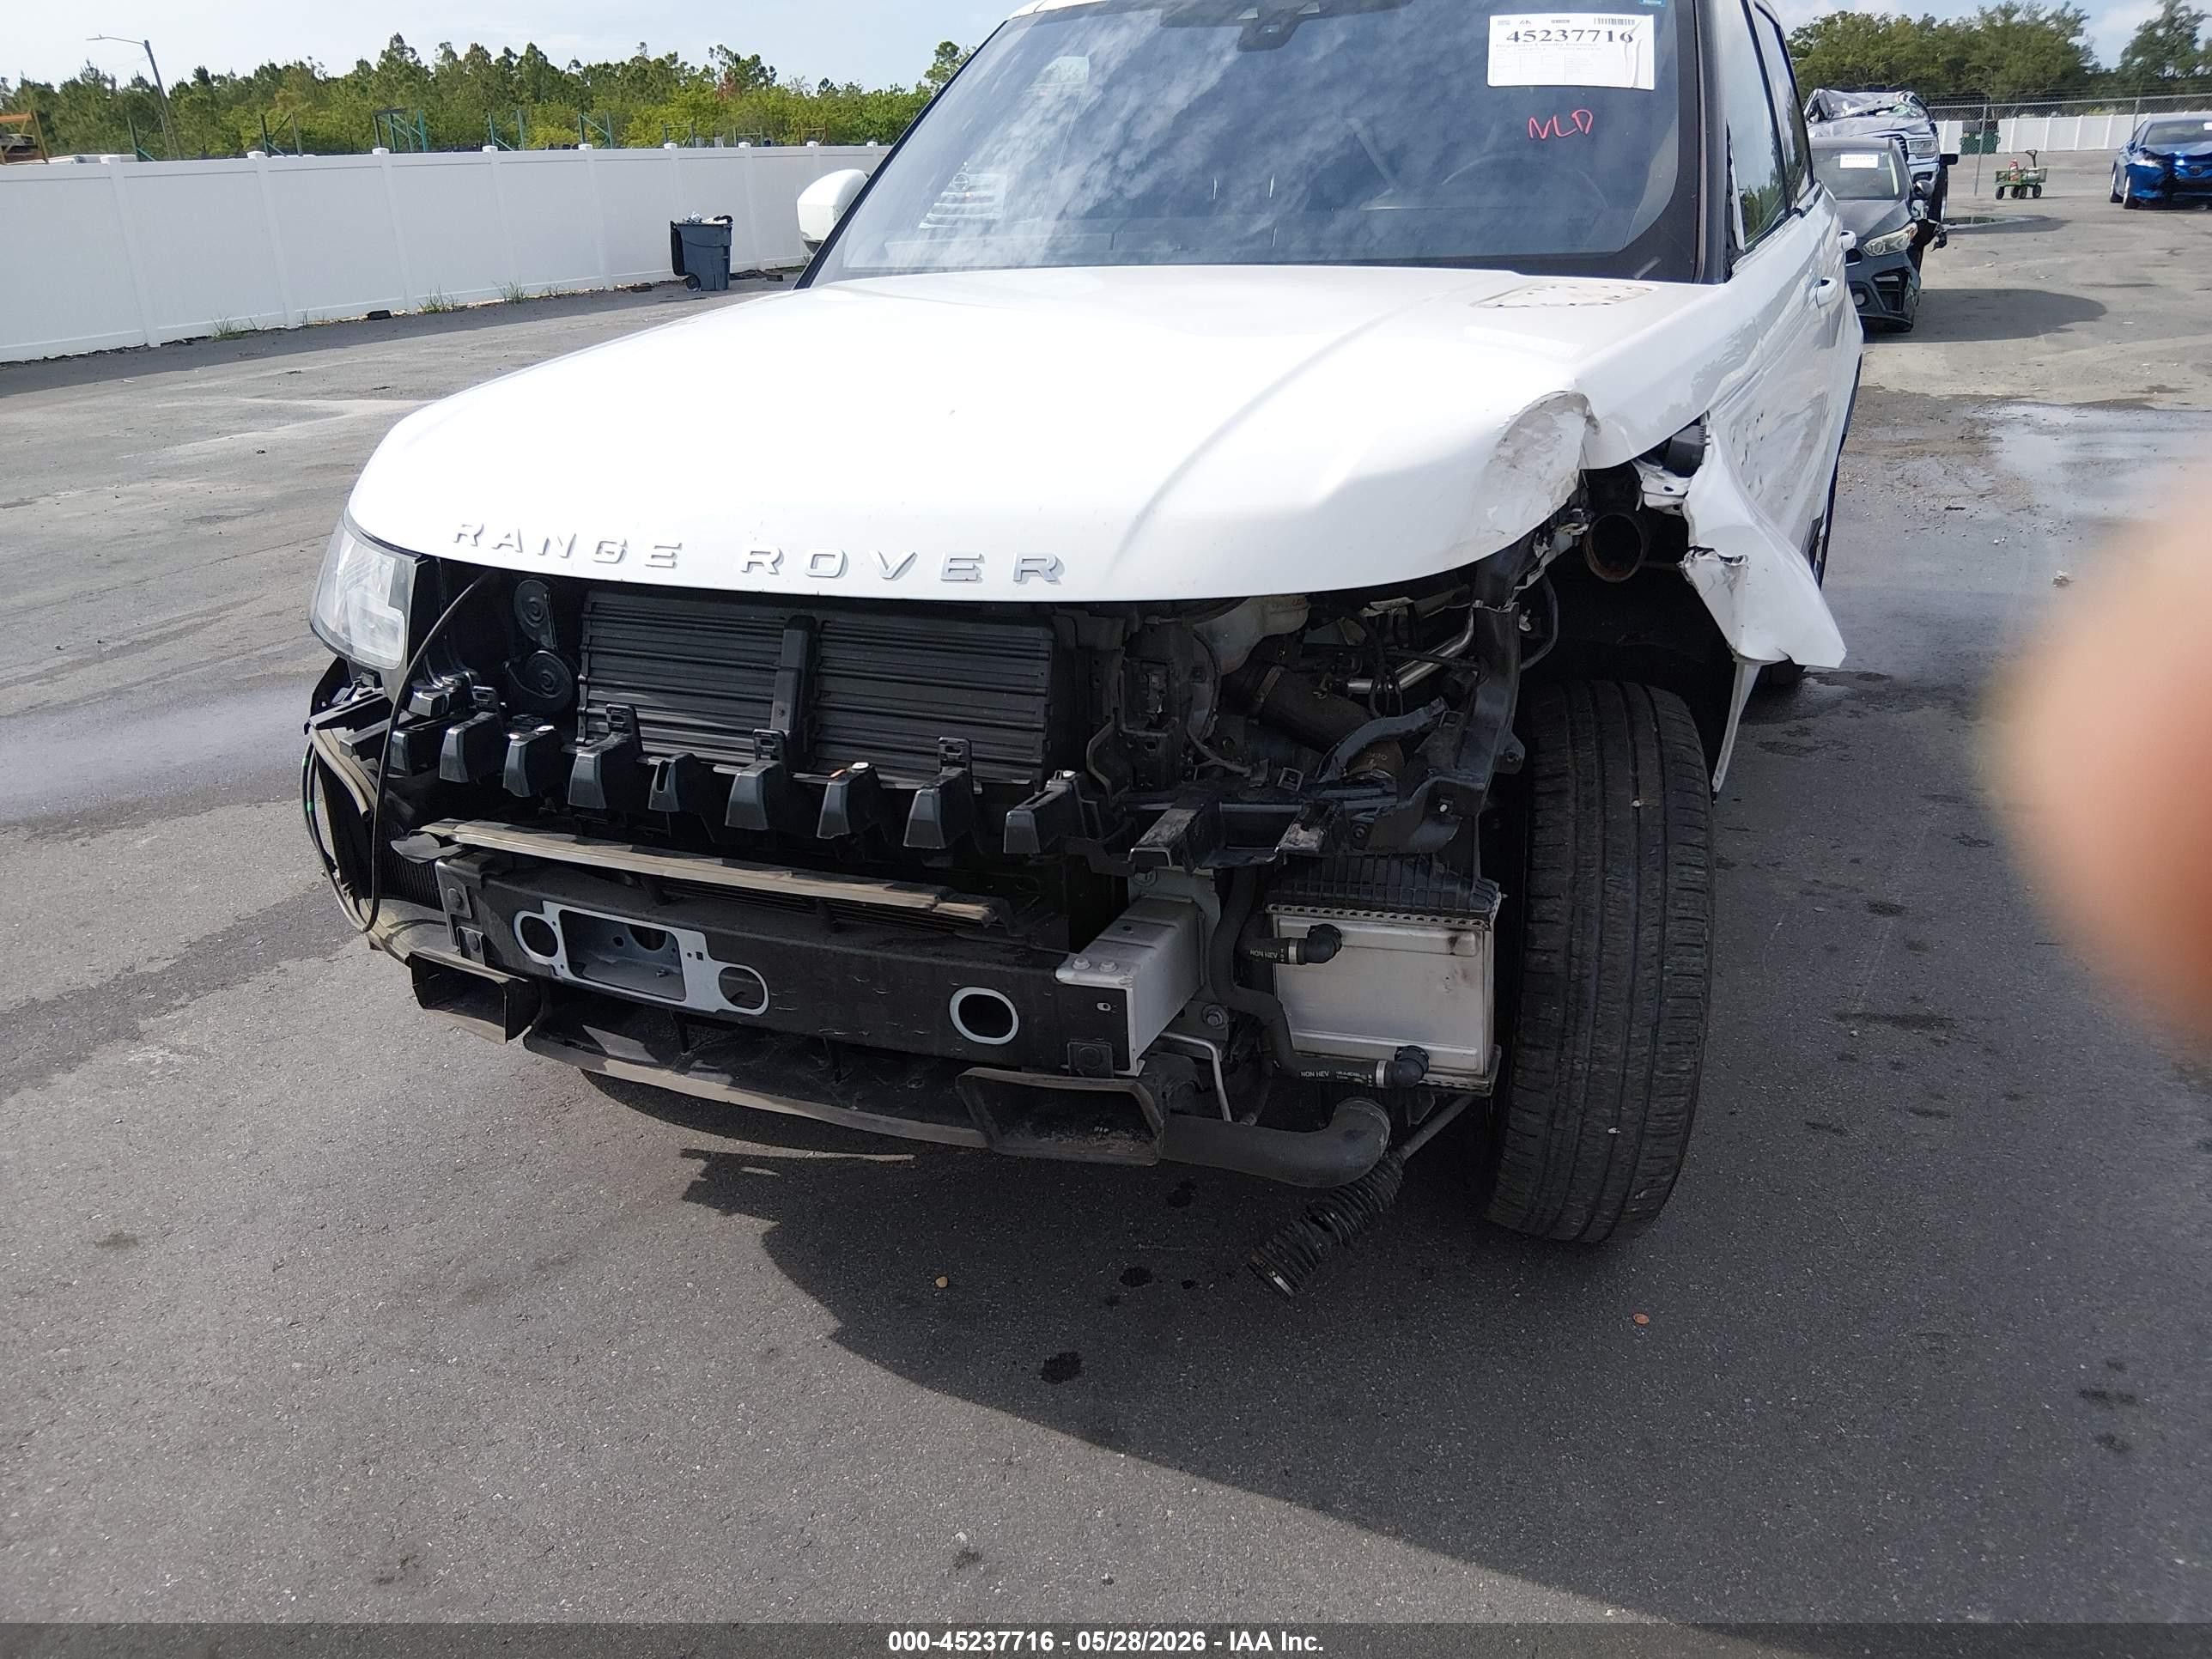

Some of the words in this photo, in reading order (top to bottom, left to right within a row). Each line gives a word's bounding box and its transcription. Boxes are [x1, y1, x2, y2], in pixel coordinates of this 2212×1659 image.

[1506, 29, 1633, 43] 45237716
[453, 522, 683, 568] RANGE
[740, 545, 1065, 583] ROVER
